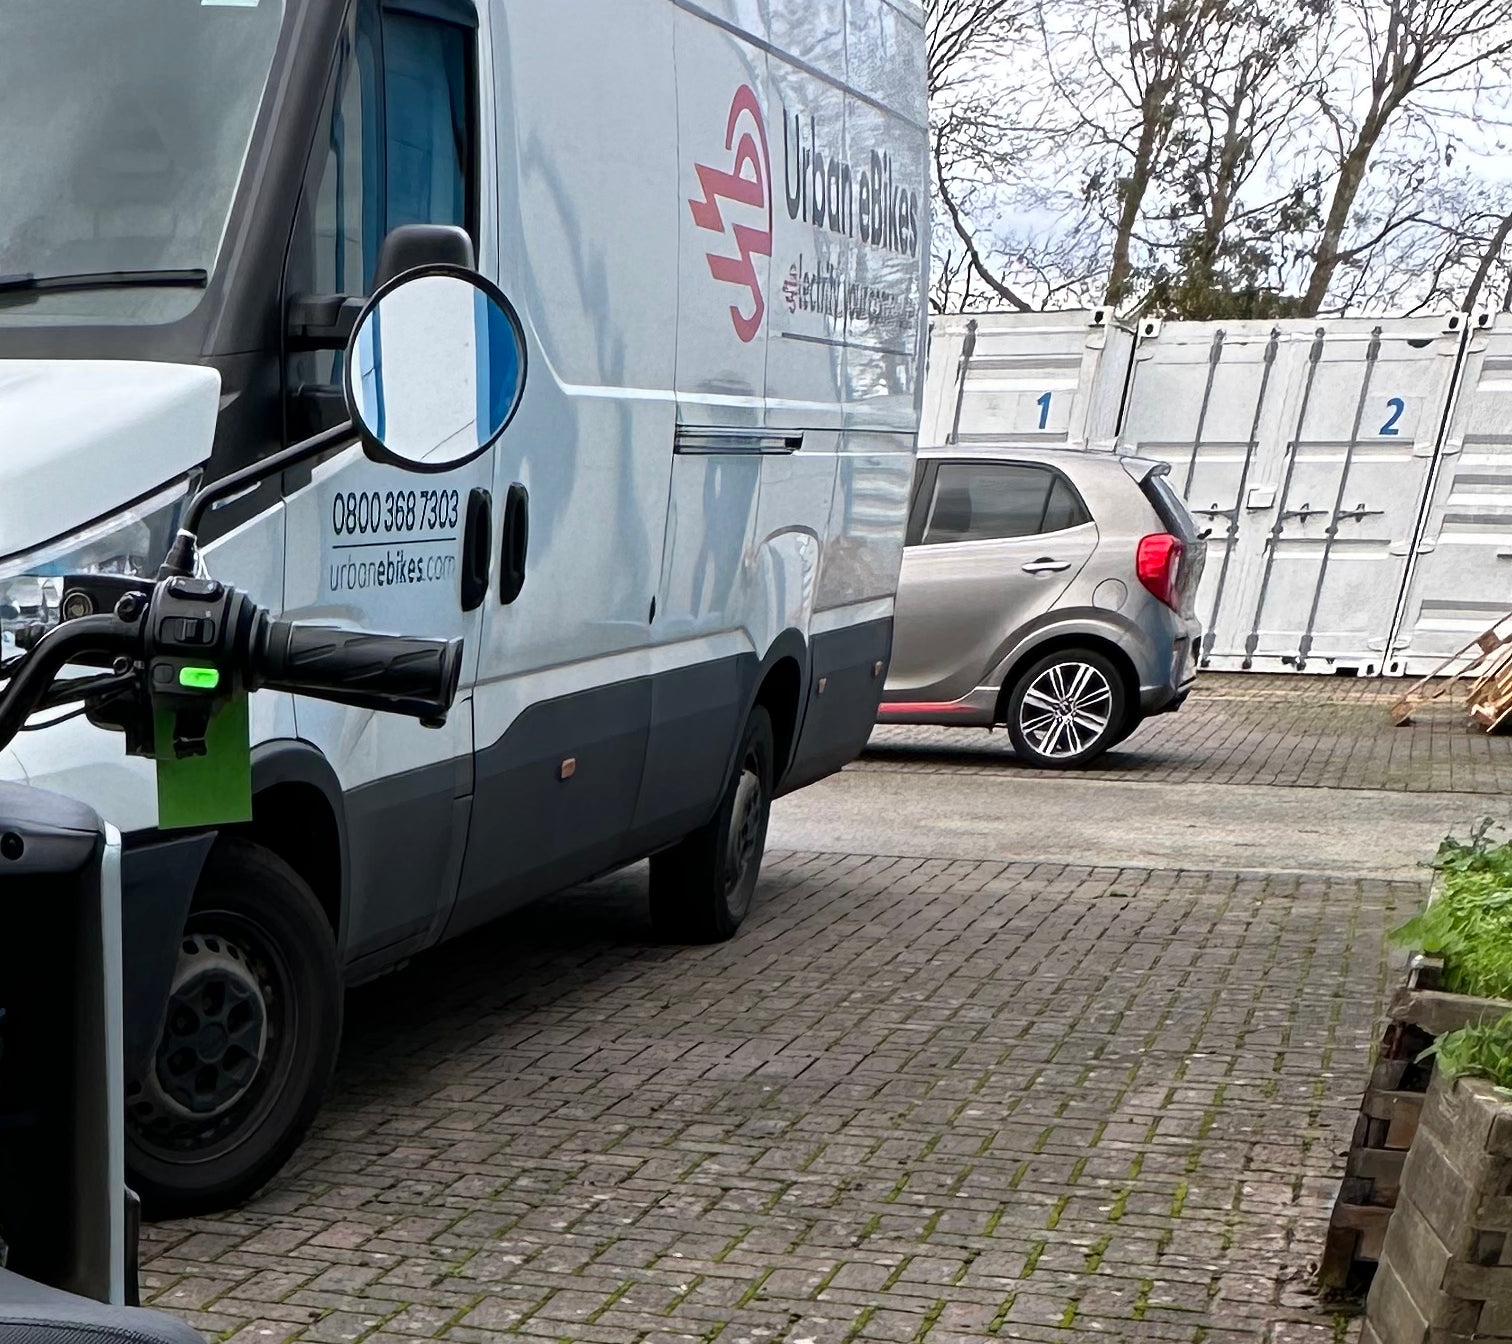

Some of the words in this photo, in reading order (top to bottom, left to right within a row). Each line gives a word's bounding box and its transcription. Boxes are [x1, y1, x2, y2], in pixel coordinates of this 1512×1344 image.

[783, 108, 854, 238] Urban
[859, 149, 918, 258] eBikes
[1036, 391, 1053, 430] 1
[1378, 397, 1406, 436] 2
[333, 491, 381, 535] 0800
[384, 490, 416, 532] 368
[419, 489, 459, 531] 7303
[330, 550, 456, 591] urbanebikes.com
